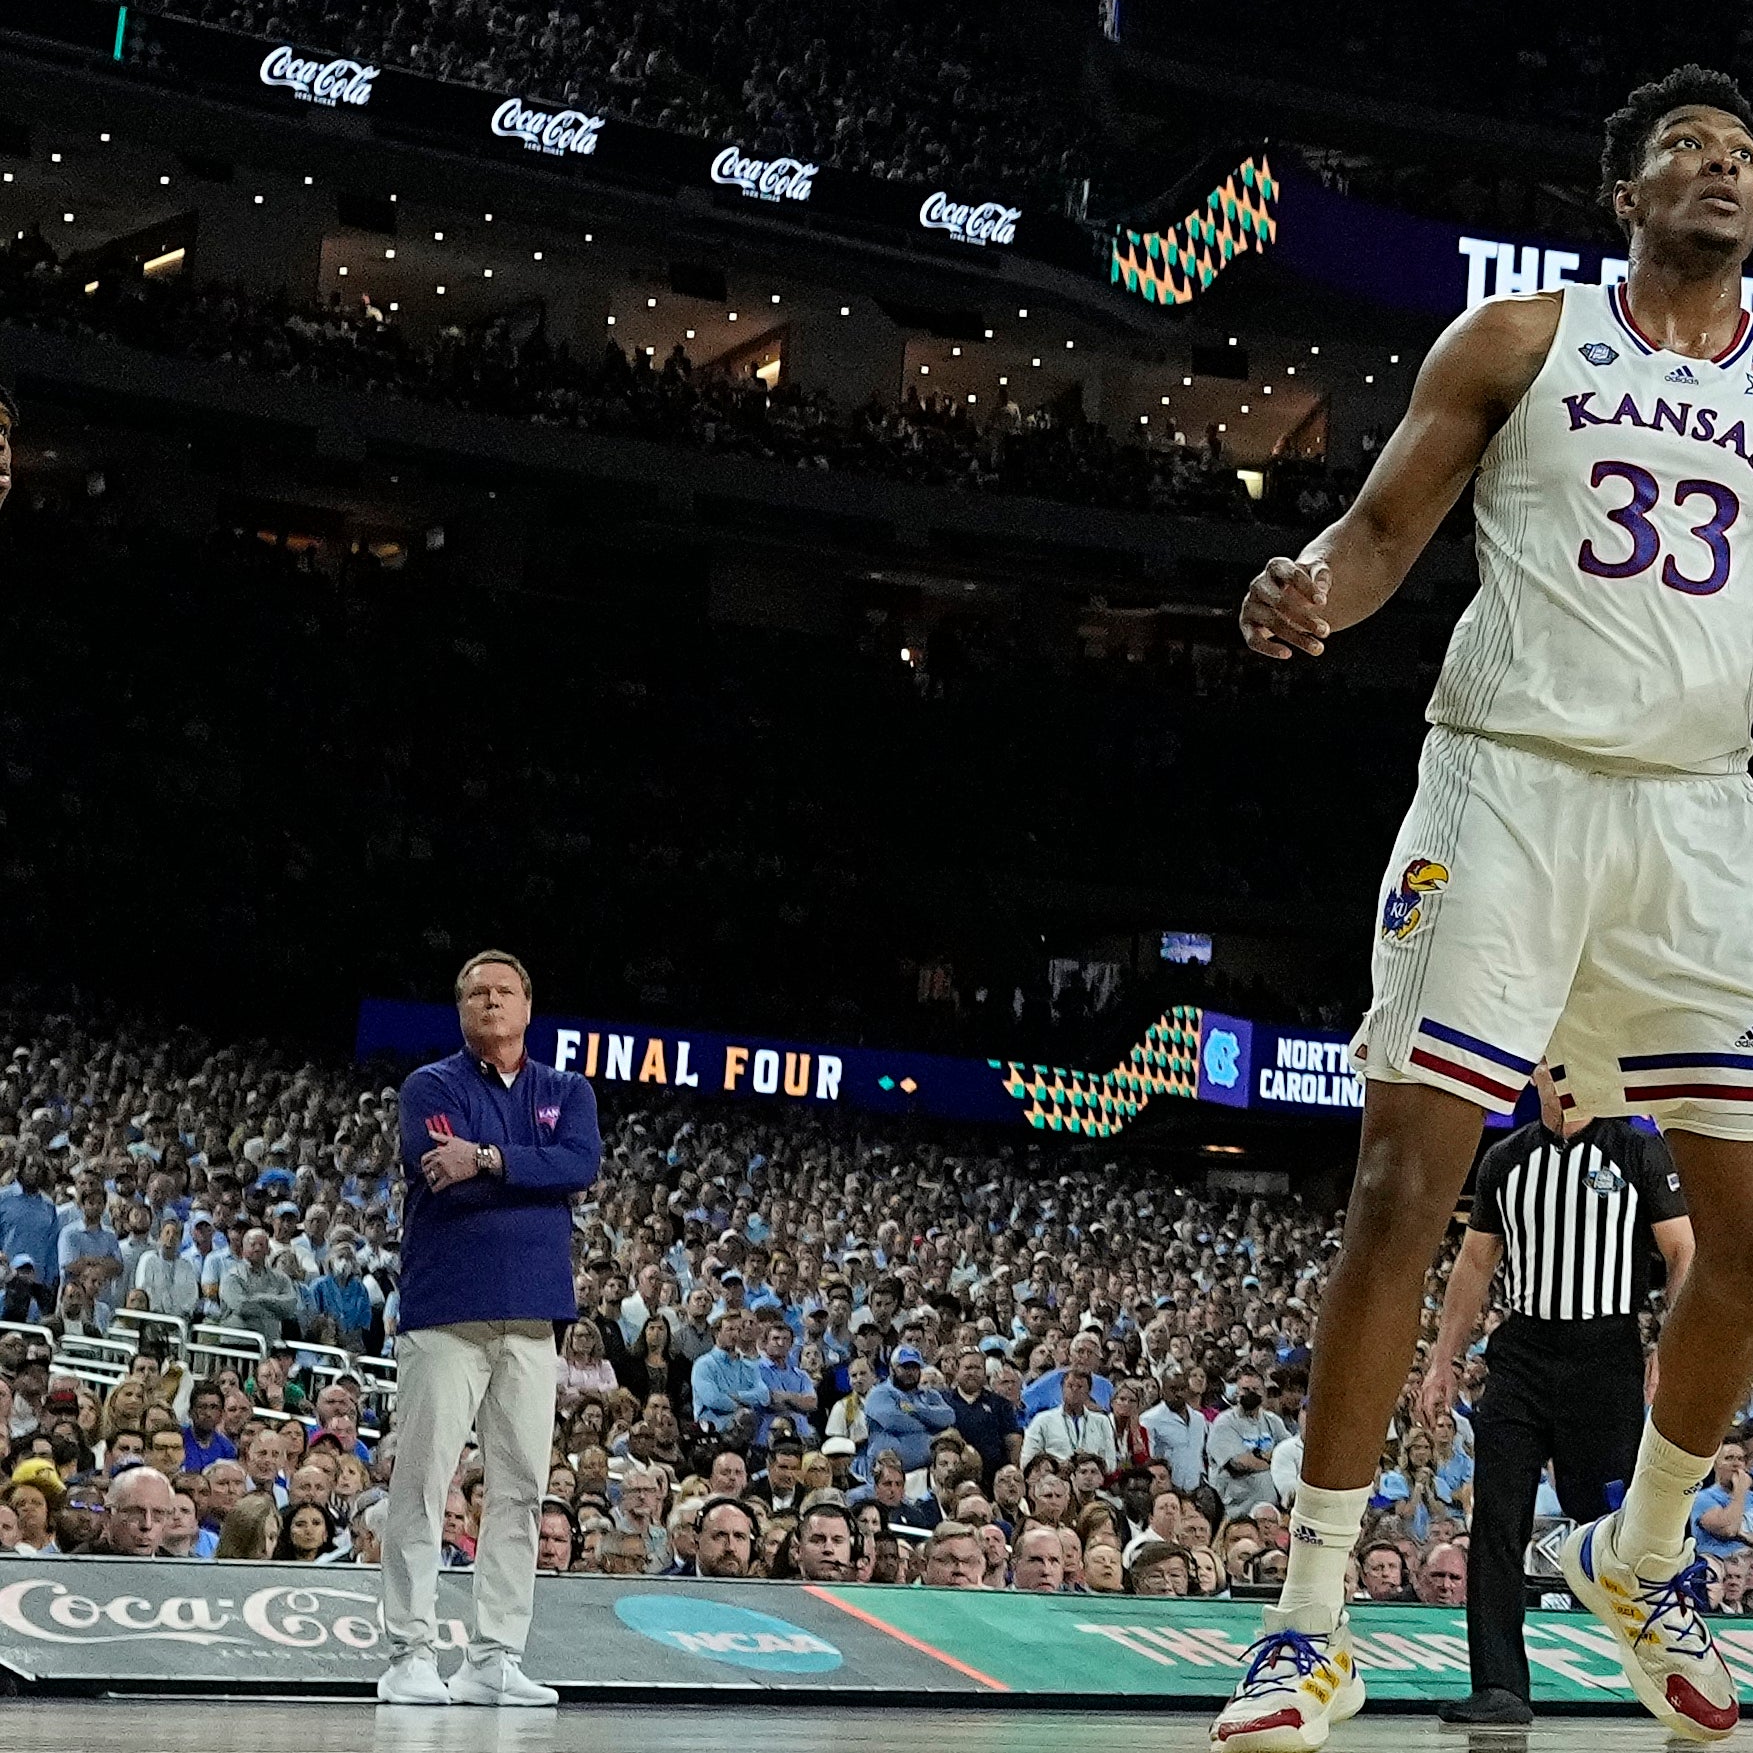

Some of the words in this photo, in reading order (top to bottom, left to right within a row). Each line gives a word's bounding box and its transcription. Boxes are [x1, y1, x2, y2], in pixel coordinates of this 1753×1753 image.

[260, 46, 381, 105] Coca-Cola
[491, 98, 605, 155] Coca-Cola
[711, 146, 819, 201] Coca-Cola
[920, 192, 1022, 244] Coca-Cola
[1578, 461, 1740, 596] 33
[554, 1029, 699, 1087] FINAL
[724, 1046, 843, 1100] FOUR
[0, 1579, 471, 1648] Coca-Coa
[665, 1630, 826, 1655] NCAA
